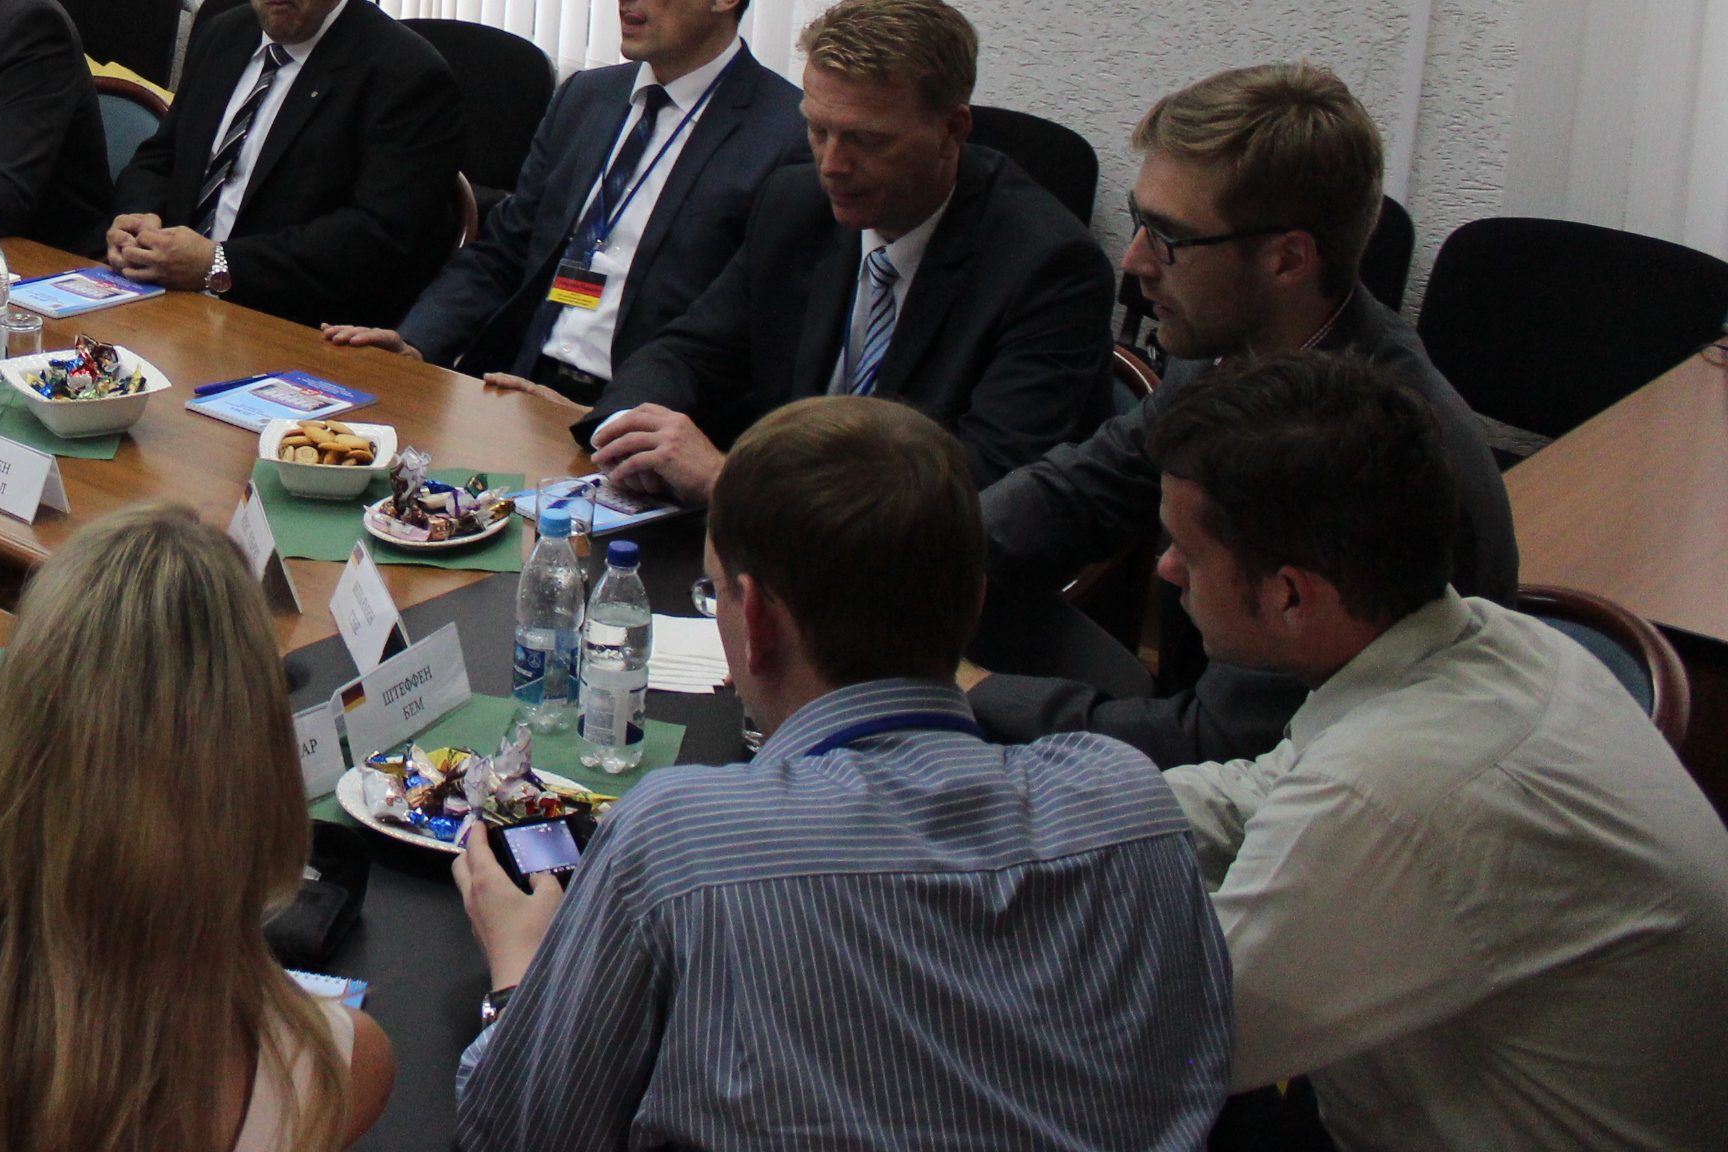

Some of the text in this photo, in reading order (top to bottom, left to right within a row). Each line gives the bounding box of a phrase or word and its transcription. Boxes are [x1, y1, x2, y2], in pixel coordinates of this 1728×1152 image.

[381, 665, 433, 706] ШТЕФФЕН
[402, 697, 424, 721] БЕМ
[301, 738, 318, 757] АР
